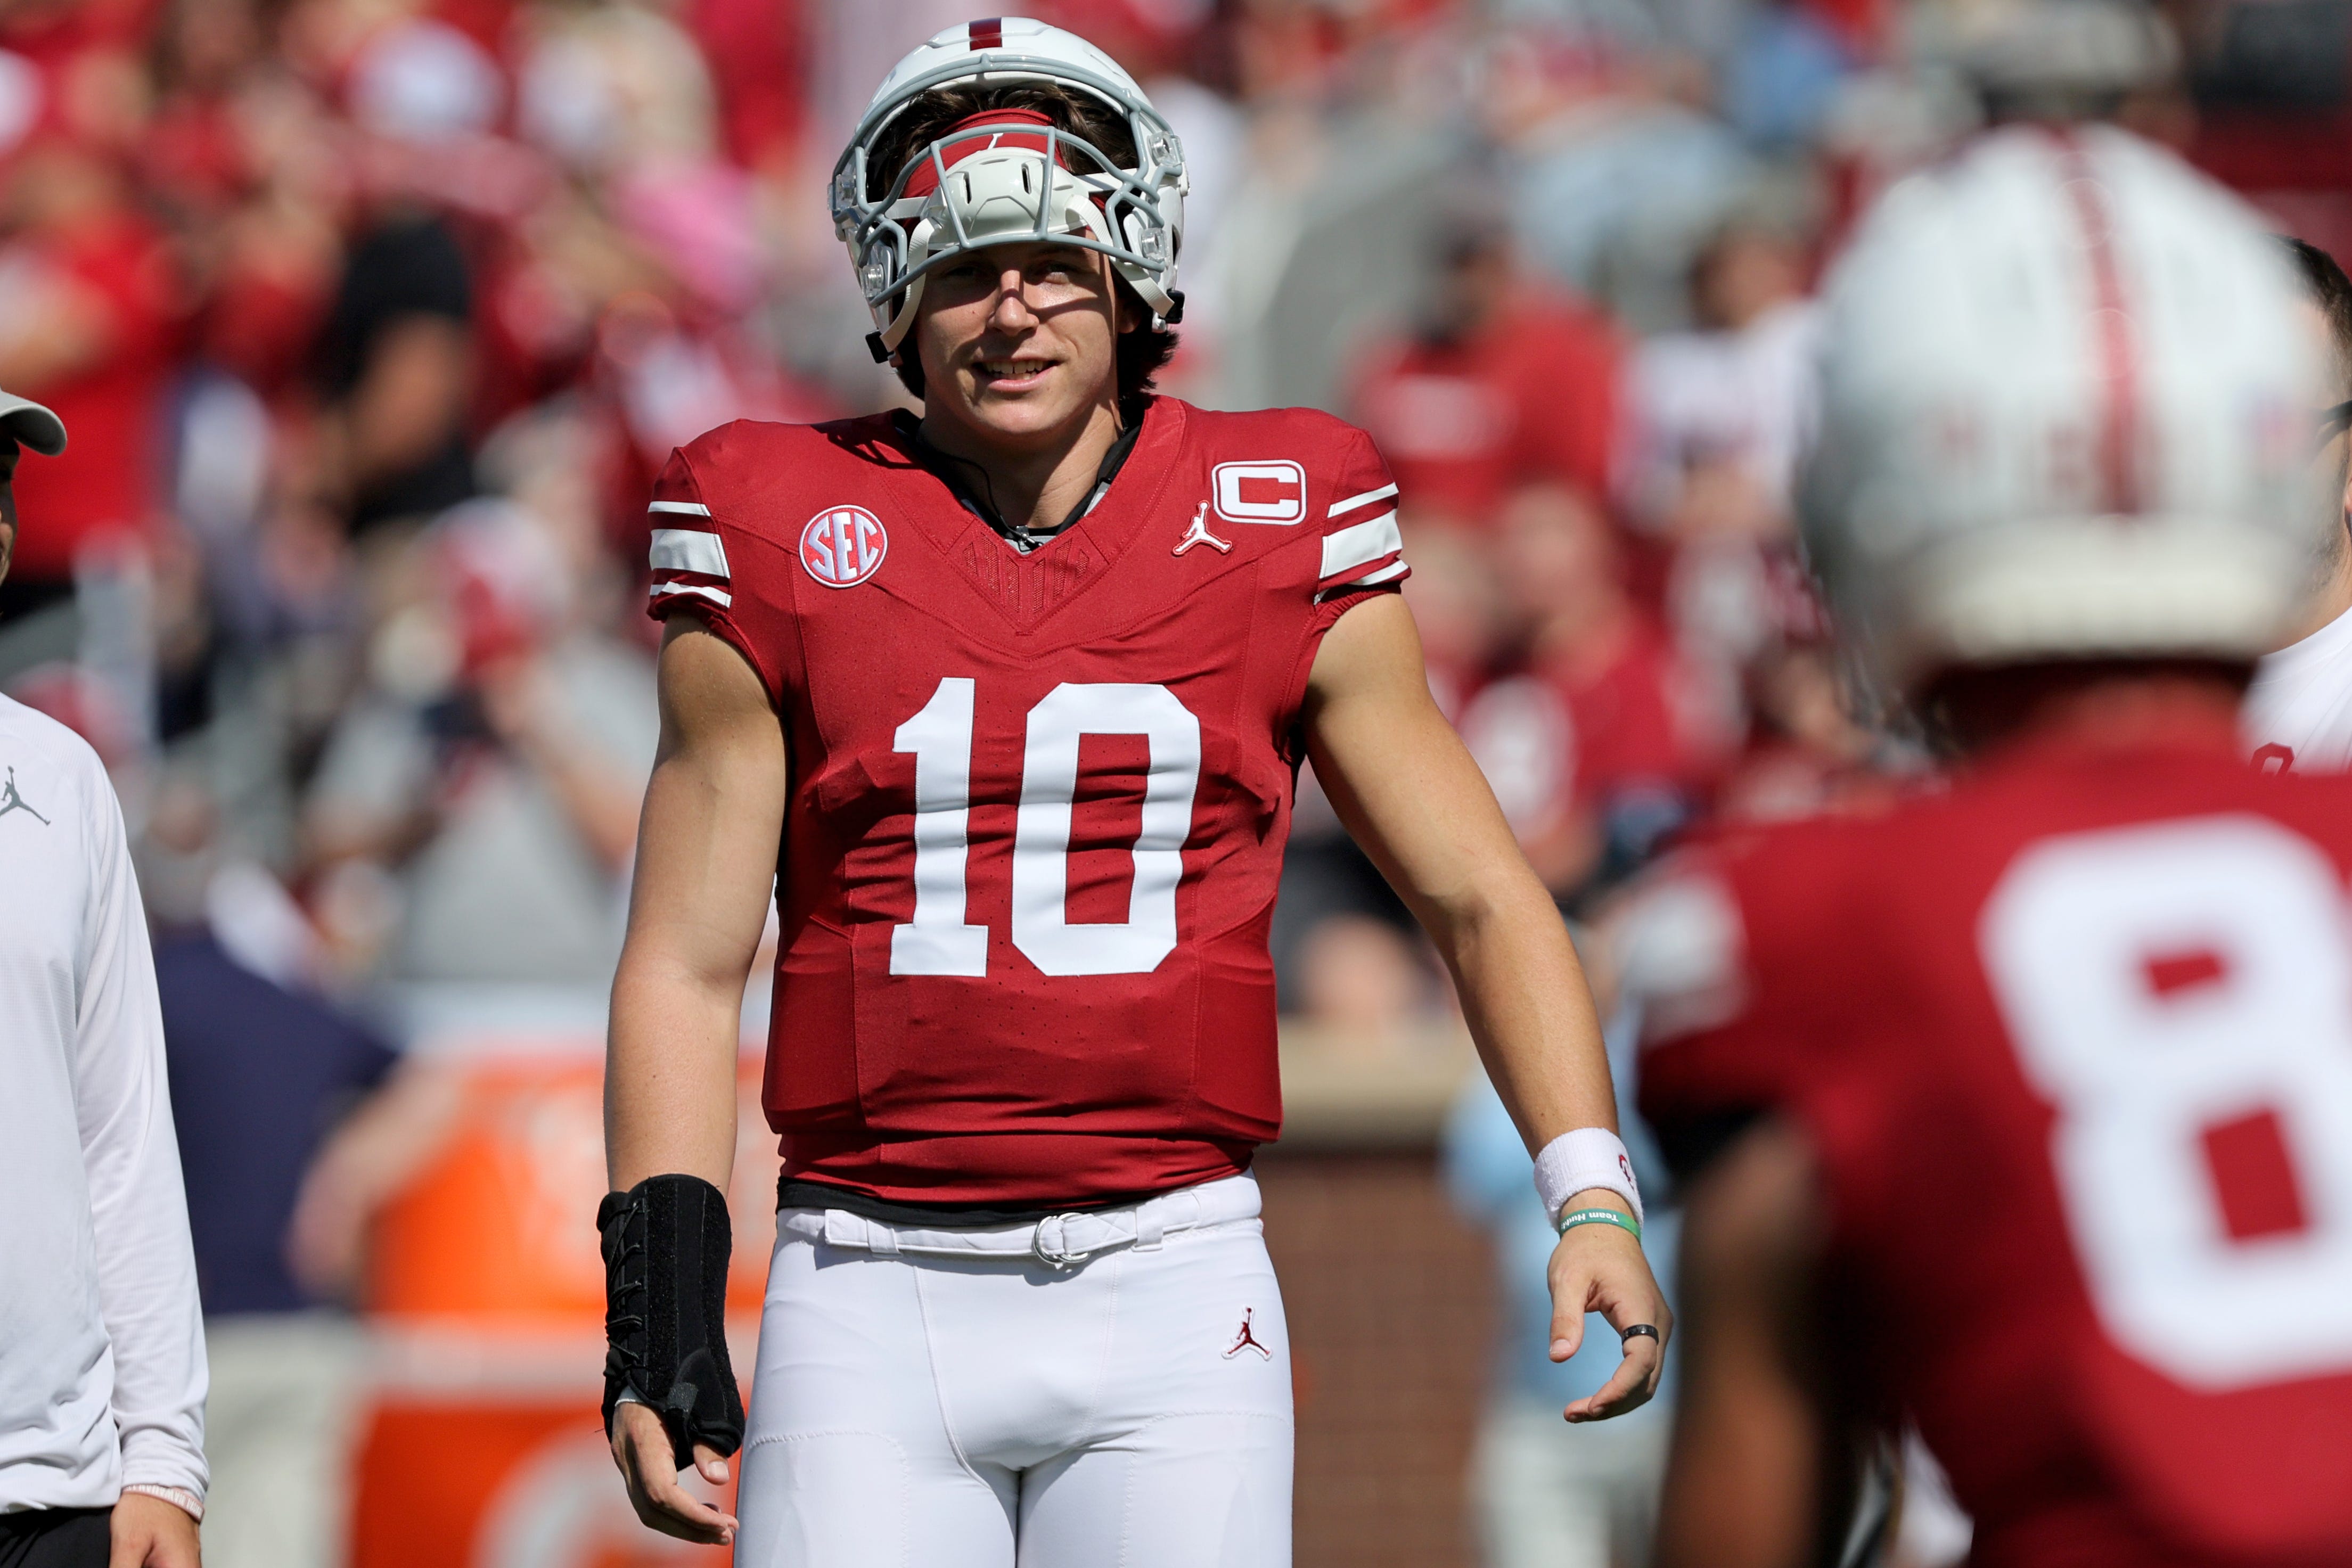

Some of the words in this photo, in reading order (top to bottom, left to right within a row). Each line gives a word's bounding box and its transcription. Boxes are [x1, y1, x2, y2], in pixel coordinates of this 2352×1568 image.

[1218, 466, 1299, 518] C
[807, 511, 880, 581] SEC
[889, 677, 1201, 978] 10
[1974, 812, 2352, 1392] 8
[1588, 1211, 1619, 1222] Team
